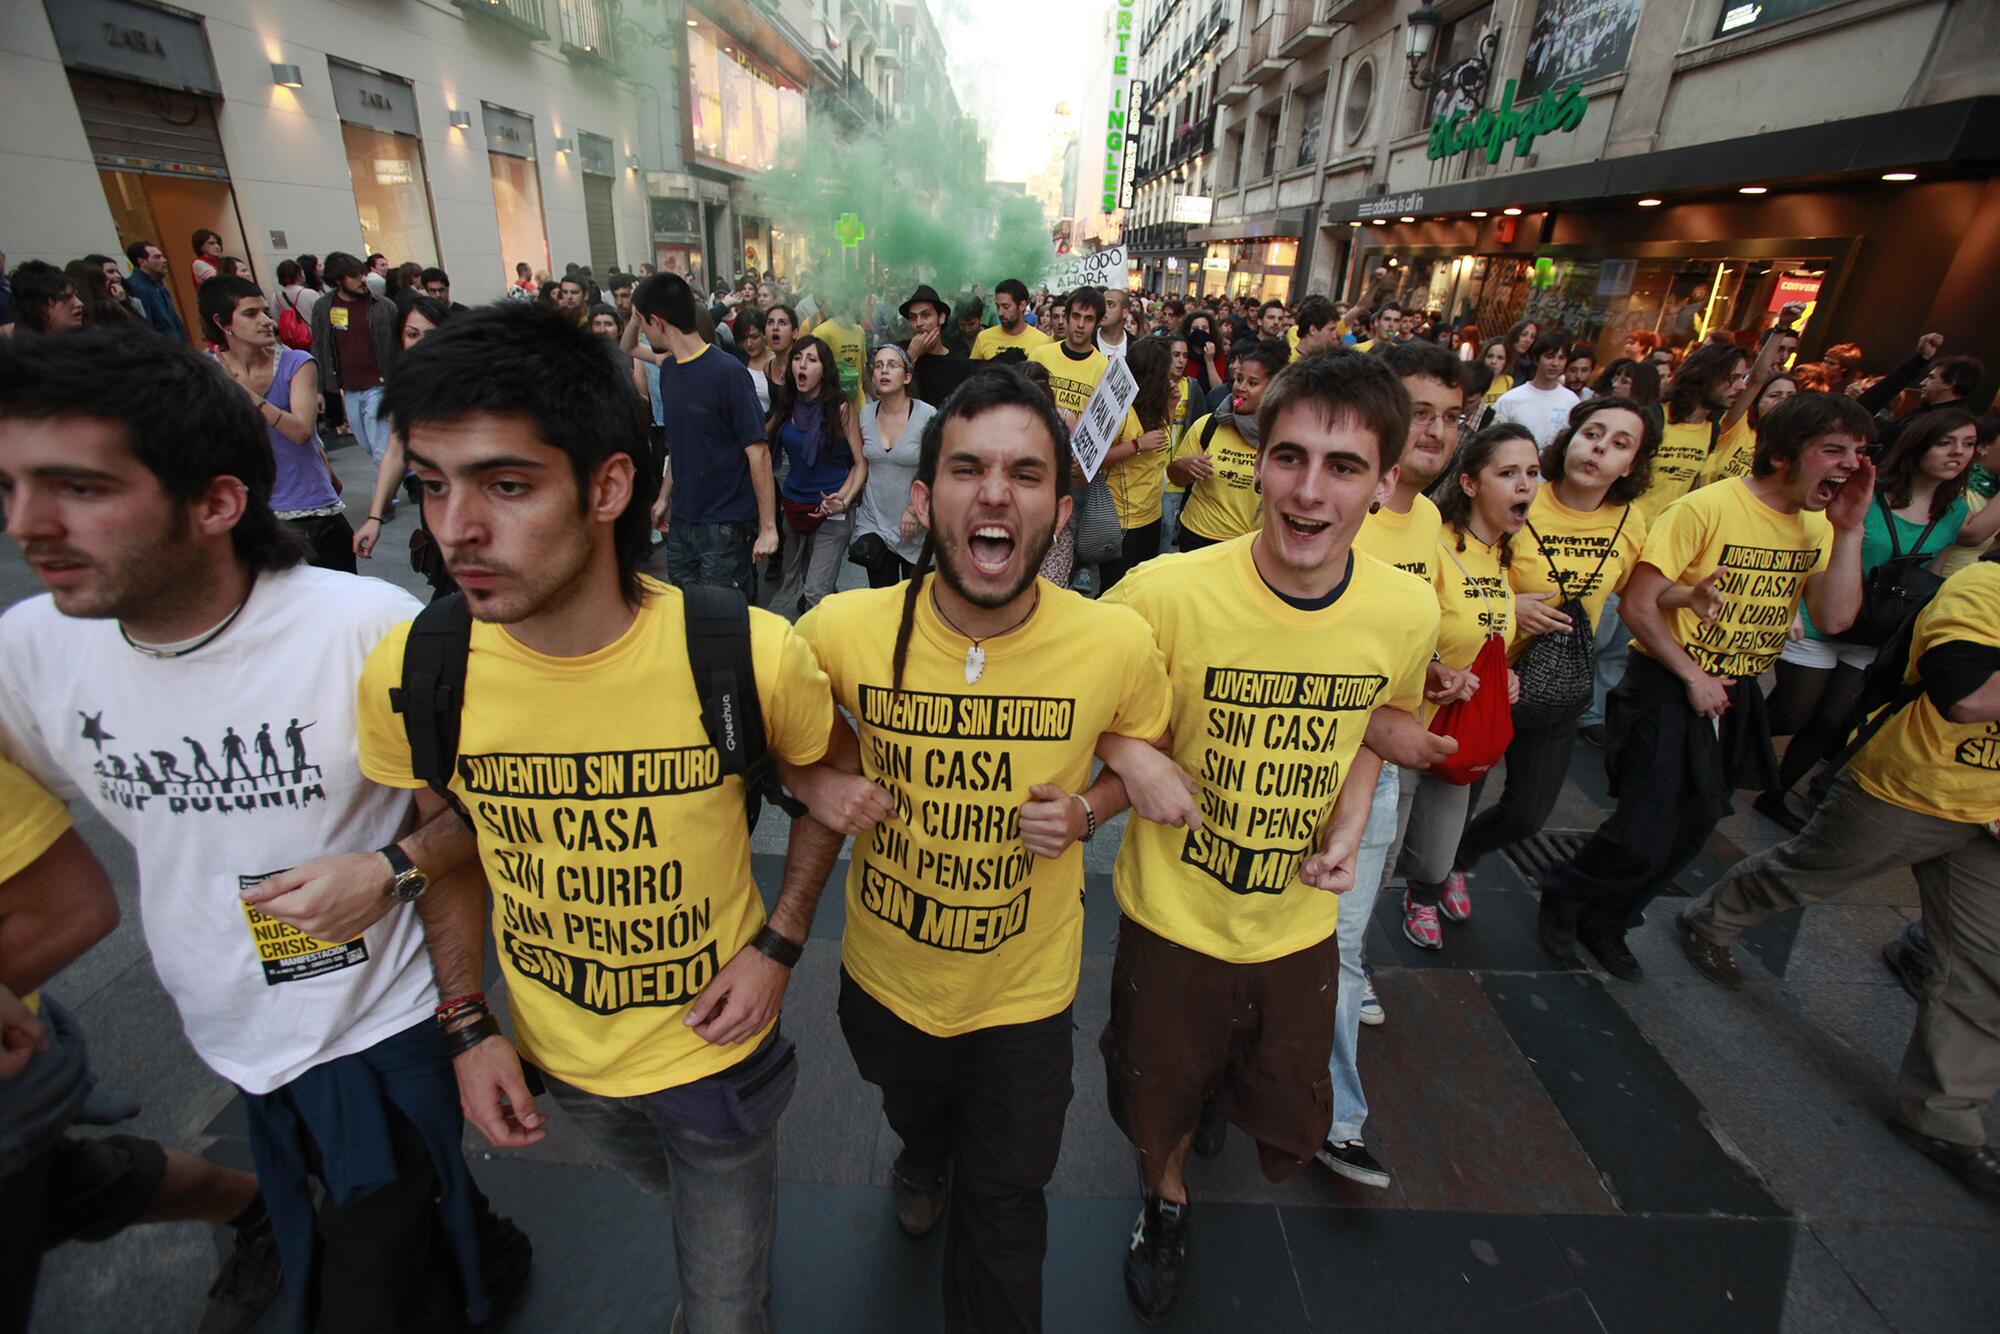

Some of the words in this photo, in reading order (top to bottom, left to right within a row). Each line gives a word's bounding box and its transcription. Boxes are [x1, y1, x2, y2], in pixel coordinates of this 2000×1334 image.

[103, 22, 167, 59] ZARA
[358, 89, 393, 112] ZARA
[1103, 89, 1125, 213] INGLES
[1372, 197, 1397, 216] adidas
[1057, 271, 1108, 288] AHORA
[1084, 249, 1122, 271] TODO
[1059, 391, 1081, 407] CASA
[1723, 547, 1774, 569] JUVENTUD
[1773, 551, 1794, 570] SIN
[1714, 572, 1750, 596] SIN
[1750, 575, 1797, 598] CASA
[1692, 622, 1727, 648] SIN
[1210, 670, 1298, 705] JUVENTUD
[1300, 675, 1332, 707] SIN
[722, 694, 737, 752] Quechua
[865, 688, 954, 735] JUVENTUD
[957, 697, 992, 736] SIN
[995, 700, 1072, 737] FUTURO
[1207, 708, 1256, 748] SIN
[1264, 714, 1339, 753] CASA
[467, 755, 578, 796] JUVENTUD
[584, 755, 625, 797] SIN
[632, 746, 721, 792] FUTURO
[872, 735, 912, 783] SIN
[925, 748, 1012, 792] CASA
[1201, 748, 1247, 792] SIN
[1255, 760, 1339, 798] CURRO
[478, 801, 544, 844] SIN
[553, 807, 658, 853] CASA
[1201, 787, 1239, 831] SIN
[494, 848, 544, 900] SIN
[556, 859, 683, 907] CURRO
[872, 821, 910, 871] SIN
[916, 846, 1035, 892] PENSIÓN
[1188, 826, 1240, 884] SIN
[502, 893, 554, 940] SIN
[563, 897, 711, 957] PENSIÓN
[864, 867, 915, 931] SIN
[918, 893, 1027, 951] MIEDO
[260, 936, 319, 959] CRISIS
[510, 938, 574, 995] SIN
[584, 951, 713, 1011] MIEDO
